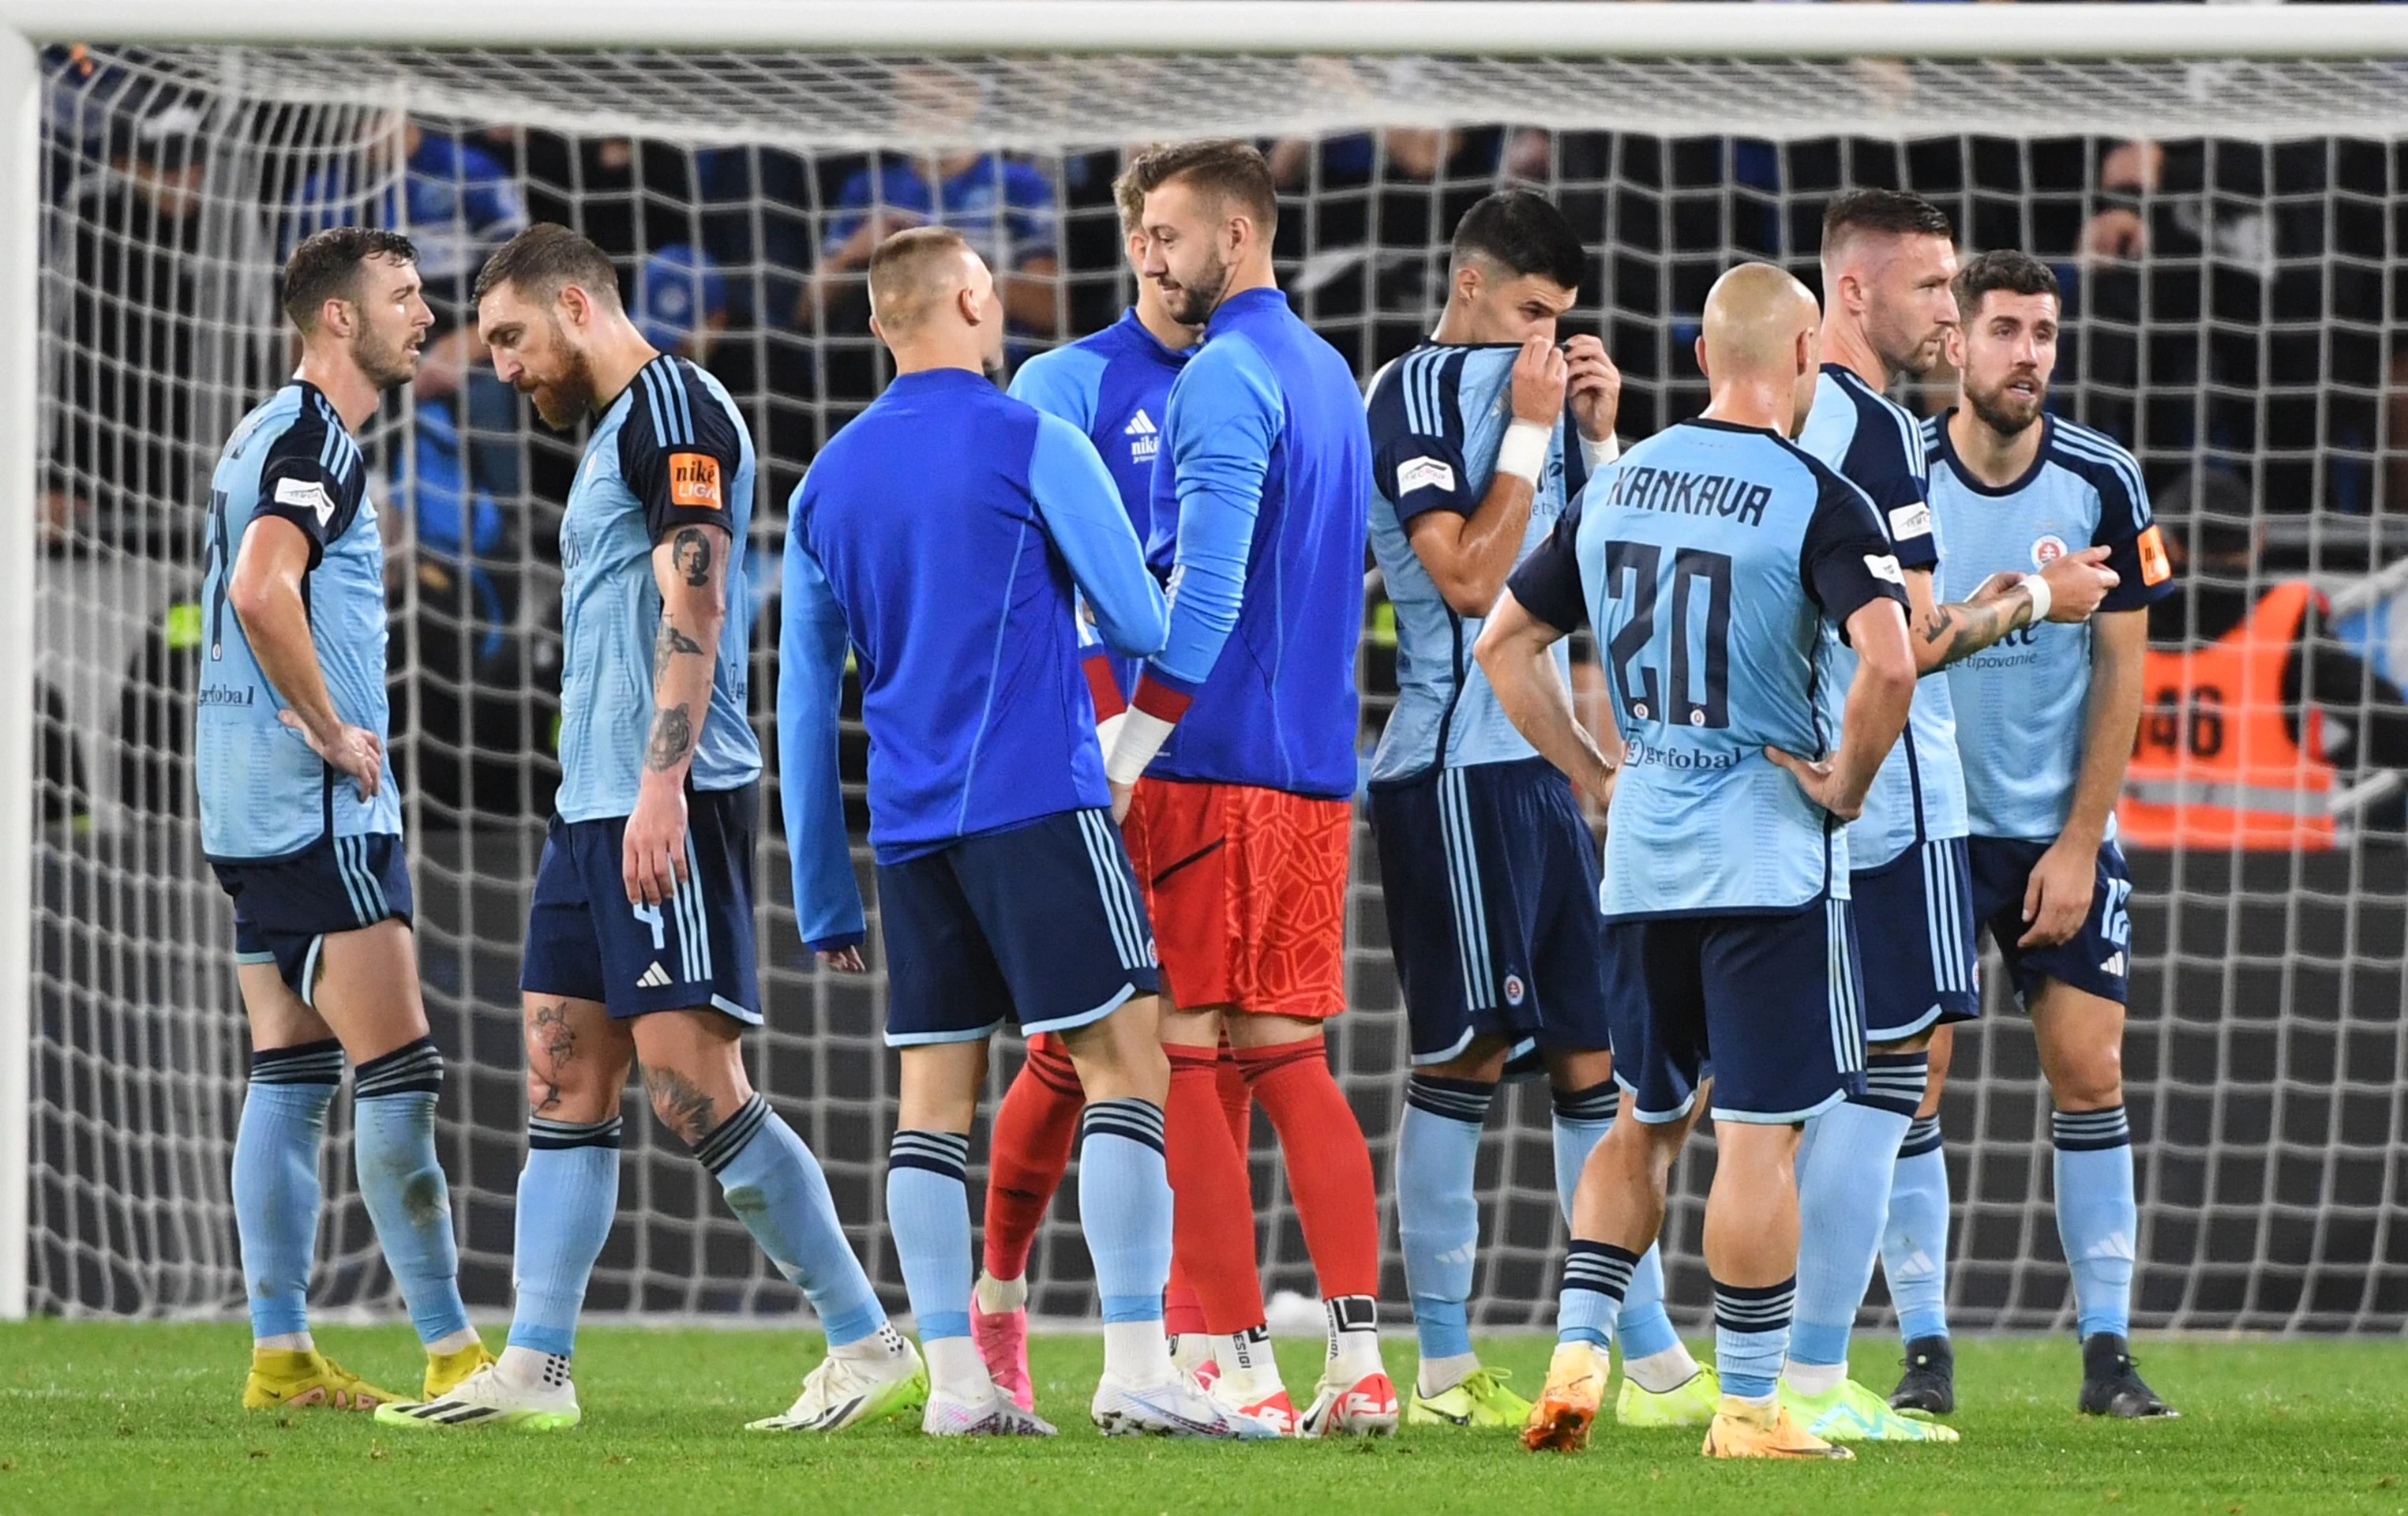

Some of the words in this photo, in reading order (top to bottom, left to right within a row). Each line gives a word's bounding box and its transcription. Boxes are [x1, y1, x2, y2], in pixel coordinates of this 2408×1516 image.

[678, 482, 718, 501] LIGA
[1606, 465, 1773, 527] KANKAVA
[1604, 540, 1732, 730] 20
[633, 902, 666, 950] 4
[2100, 876, 2132, 946] 12
